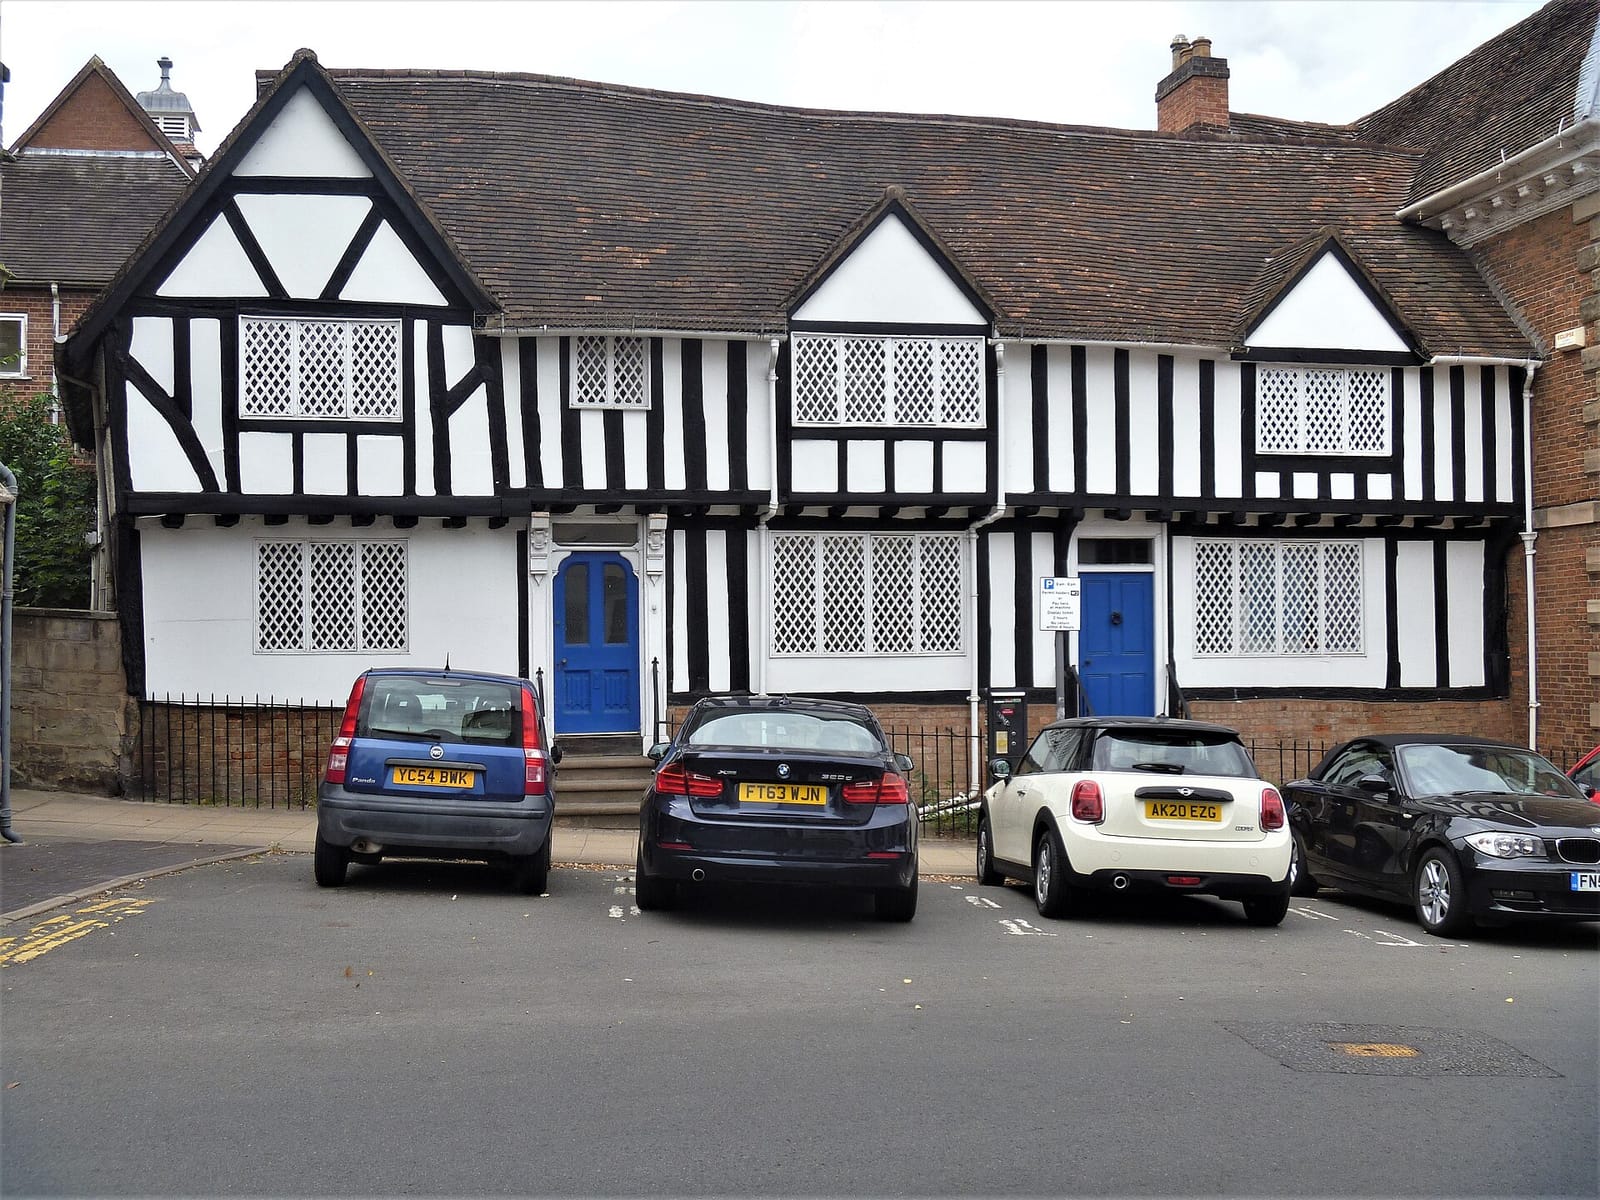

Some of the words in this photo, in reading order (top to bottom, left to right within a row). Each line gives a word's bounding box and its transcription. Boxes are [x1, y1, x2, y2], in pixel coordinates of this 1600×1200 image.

[399, 768, 436, 783] YC54
[439, 770, 468, 785] BWK
[746, 785, 786, 800] FT63
[790, 787, 820, 802] WJN
[1151, 803, 1187, 817] AK20
[1190, 805, 1216, 819] EZG
[1580, 874, 1600, 888] FN
